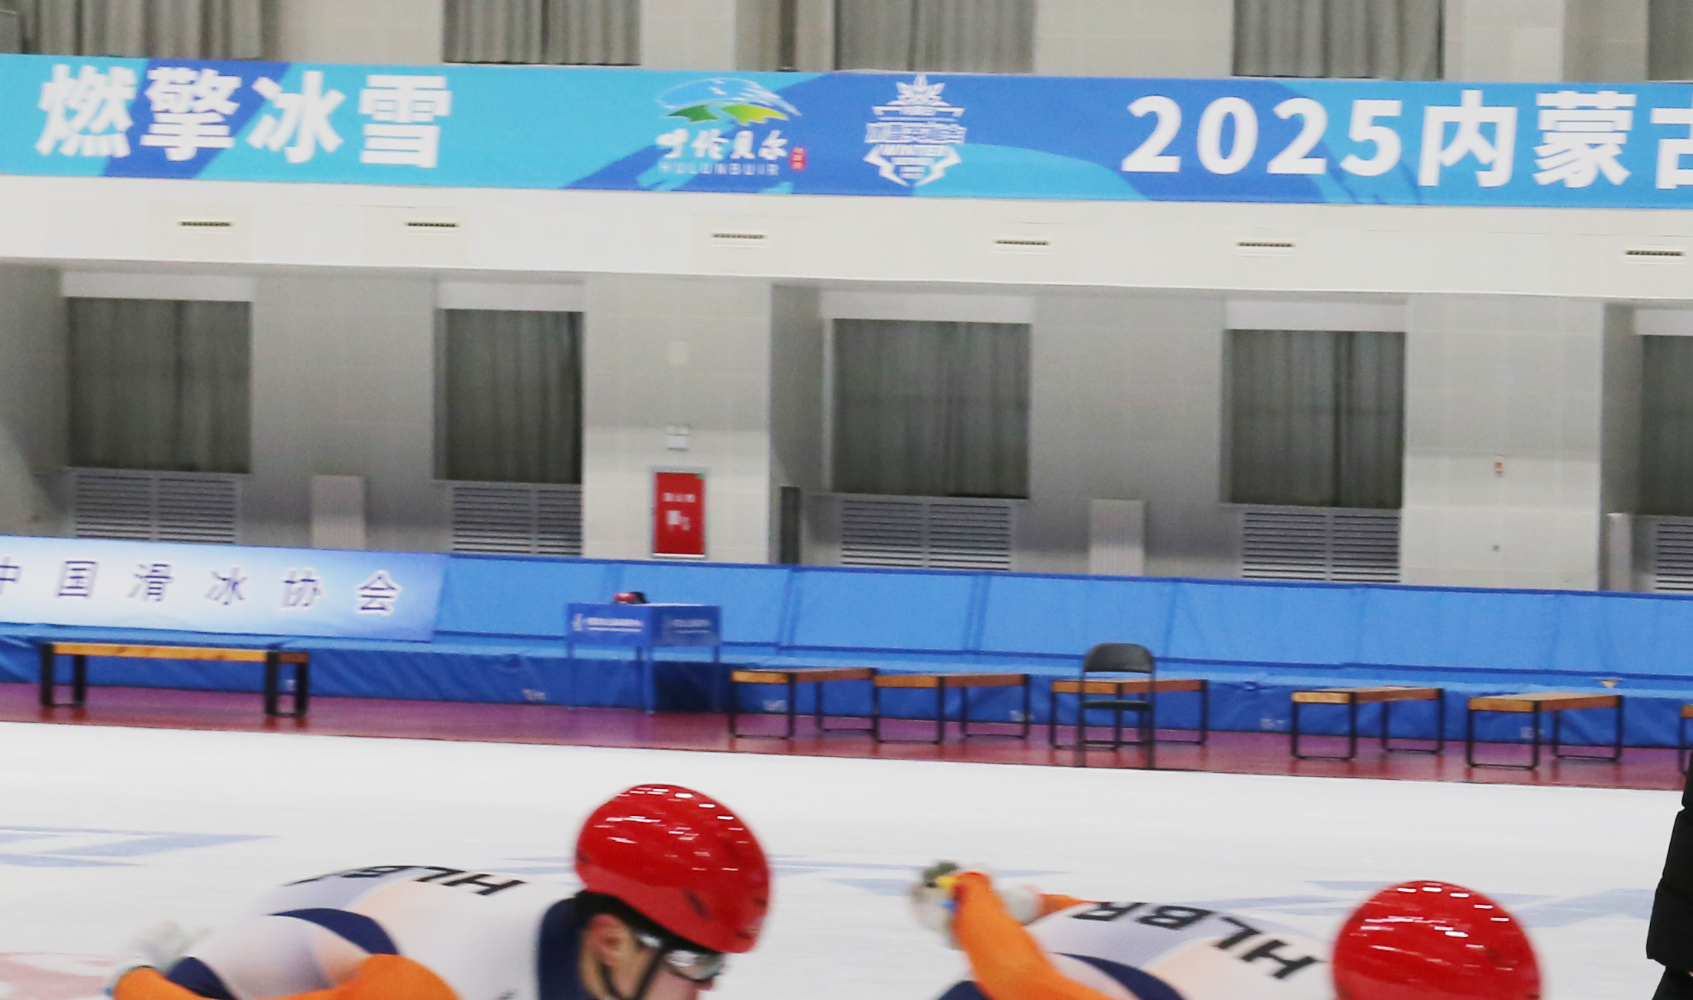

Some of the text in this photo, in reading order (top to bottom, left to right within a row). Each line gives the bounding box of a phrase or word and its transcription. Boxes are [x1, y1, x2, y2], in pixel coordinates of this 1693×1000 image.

[36, 64, 452, 168] 燃擎冰雪
[283, 865, 527, 896] HLB
[1072, 901, 1322, 979] HLBR
